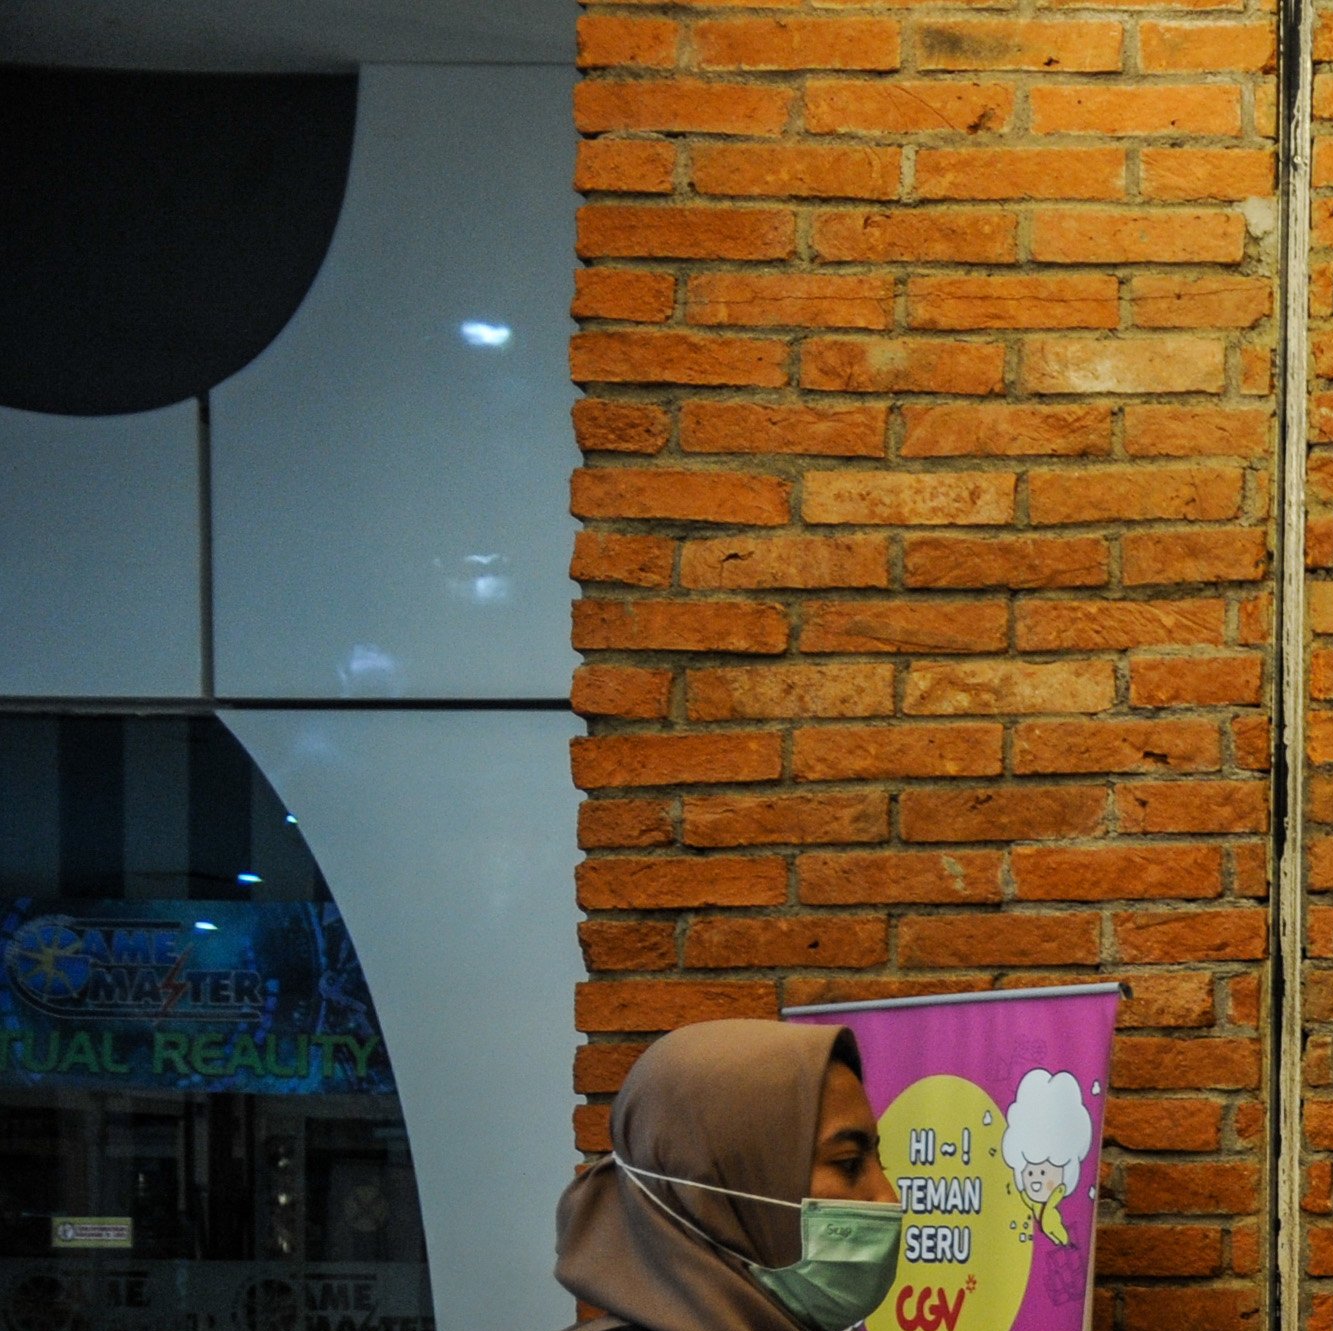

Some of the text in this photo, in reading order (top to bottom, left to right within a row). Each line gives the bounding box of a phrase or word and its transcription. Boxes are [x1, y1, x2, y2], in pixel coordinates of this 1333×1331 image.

[153, 1031, 379, 1078] REALITY
[909, 1127, 936, 1167] HI
[896, 1176, 983, 1215] TEMAN
[904, 1225, 971, 1265] SERU
